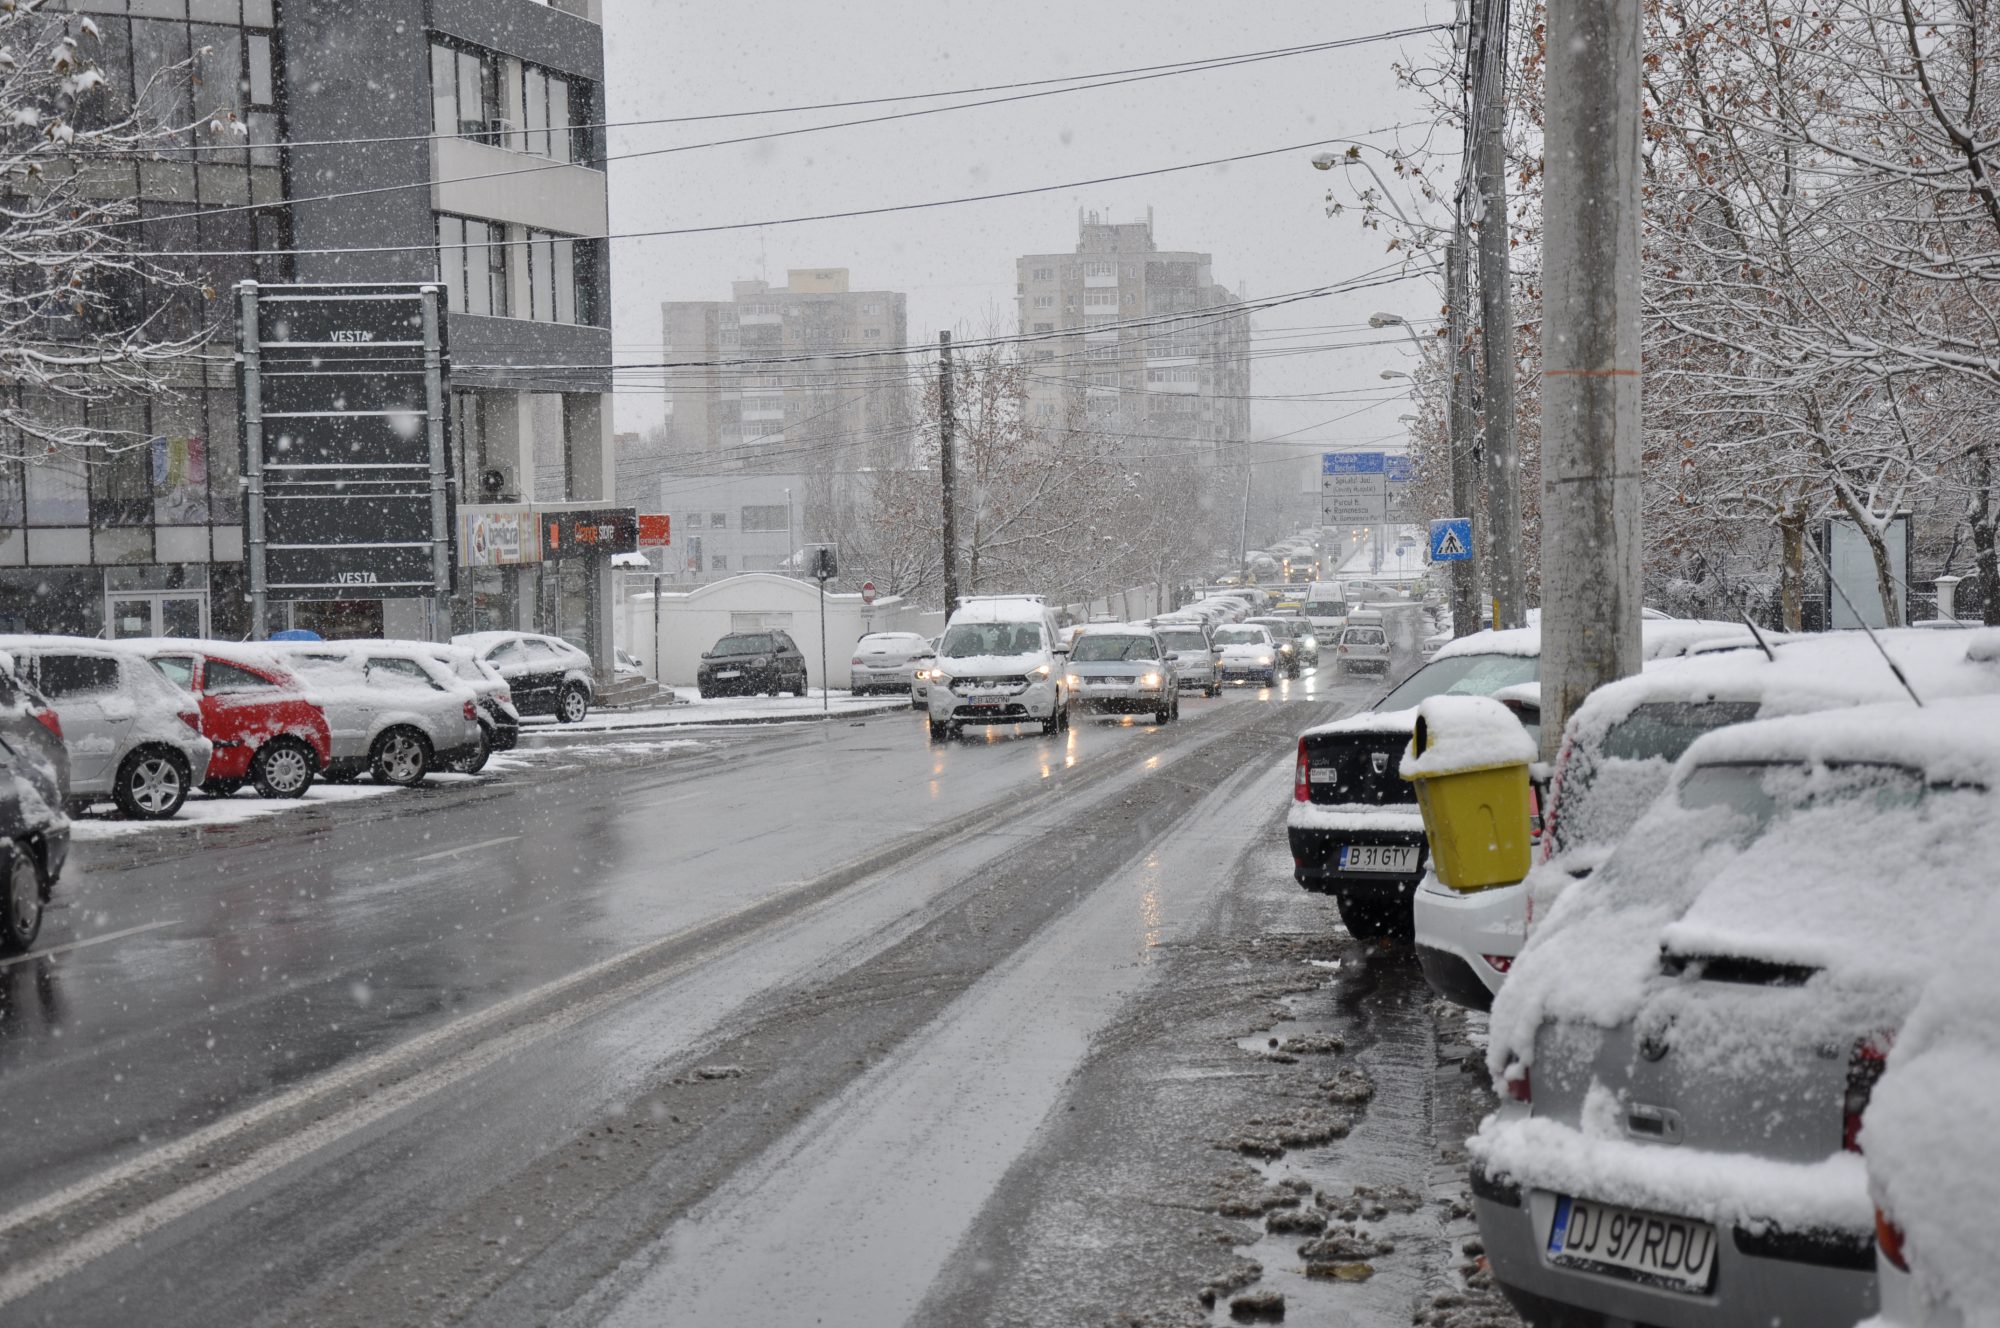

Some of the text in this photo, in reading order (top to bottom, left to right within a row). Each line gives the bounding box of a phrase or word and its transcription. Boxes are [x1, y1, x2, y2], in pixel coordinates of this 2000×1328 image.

[329, 330, 370, 342] VESTA
[640, 538, 665, 546] orange
[337, 571, 378, 584] VESTA
[1350, 848, 1410, 866] B 31 GTY
[1566, 1205, 1604, 1253] DJ
